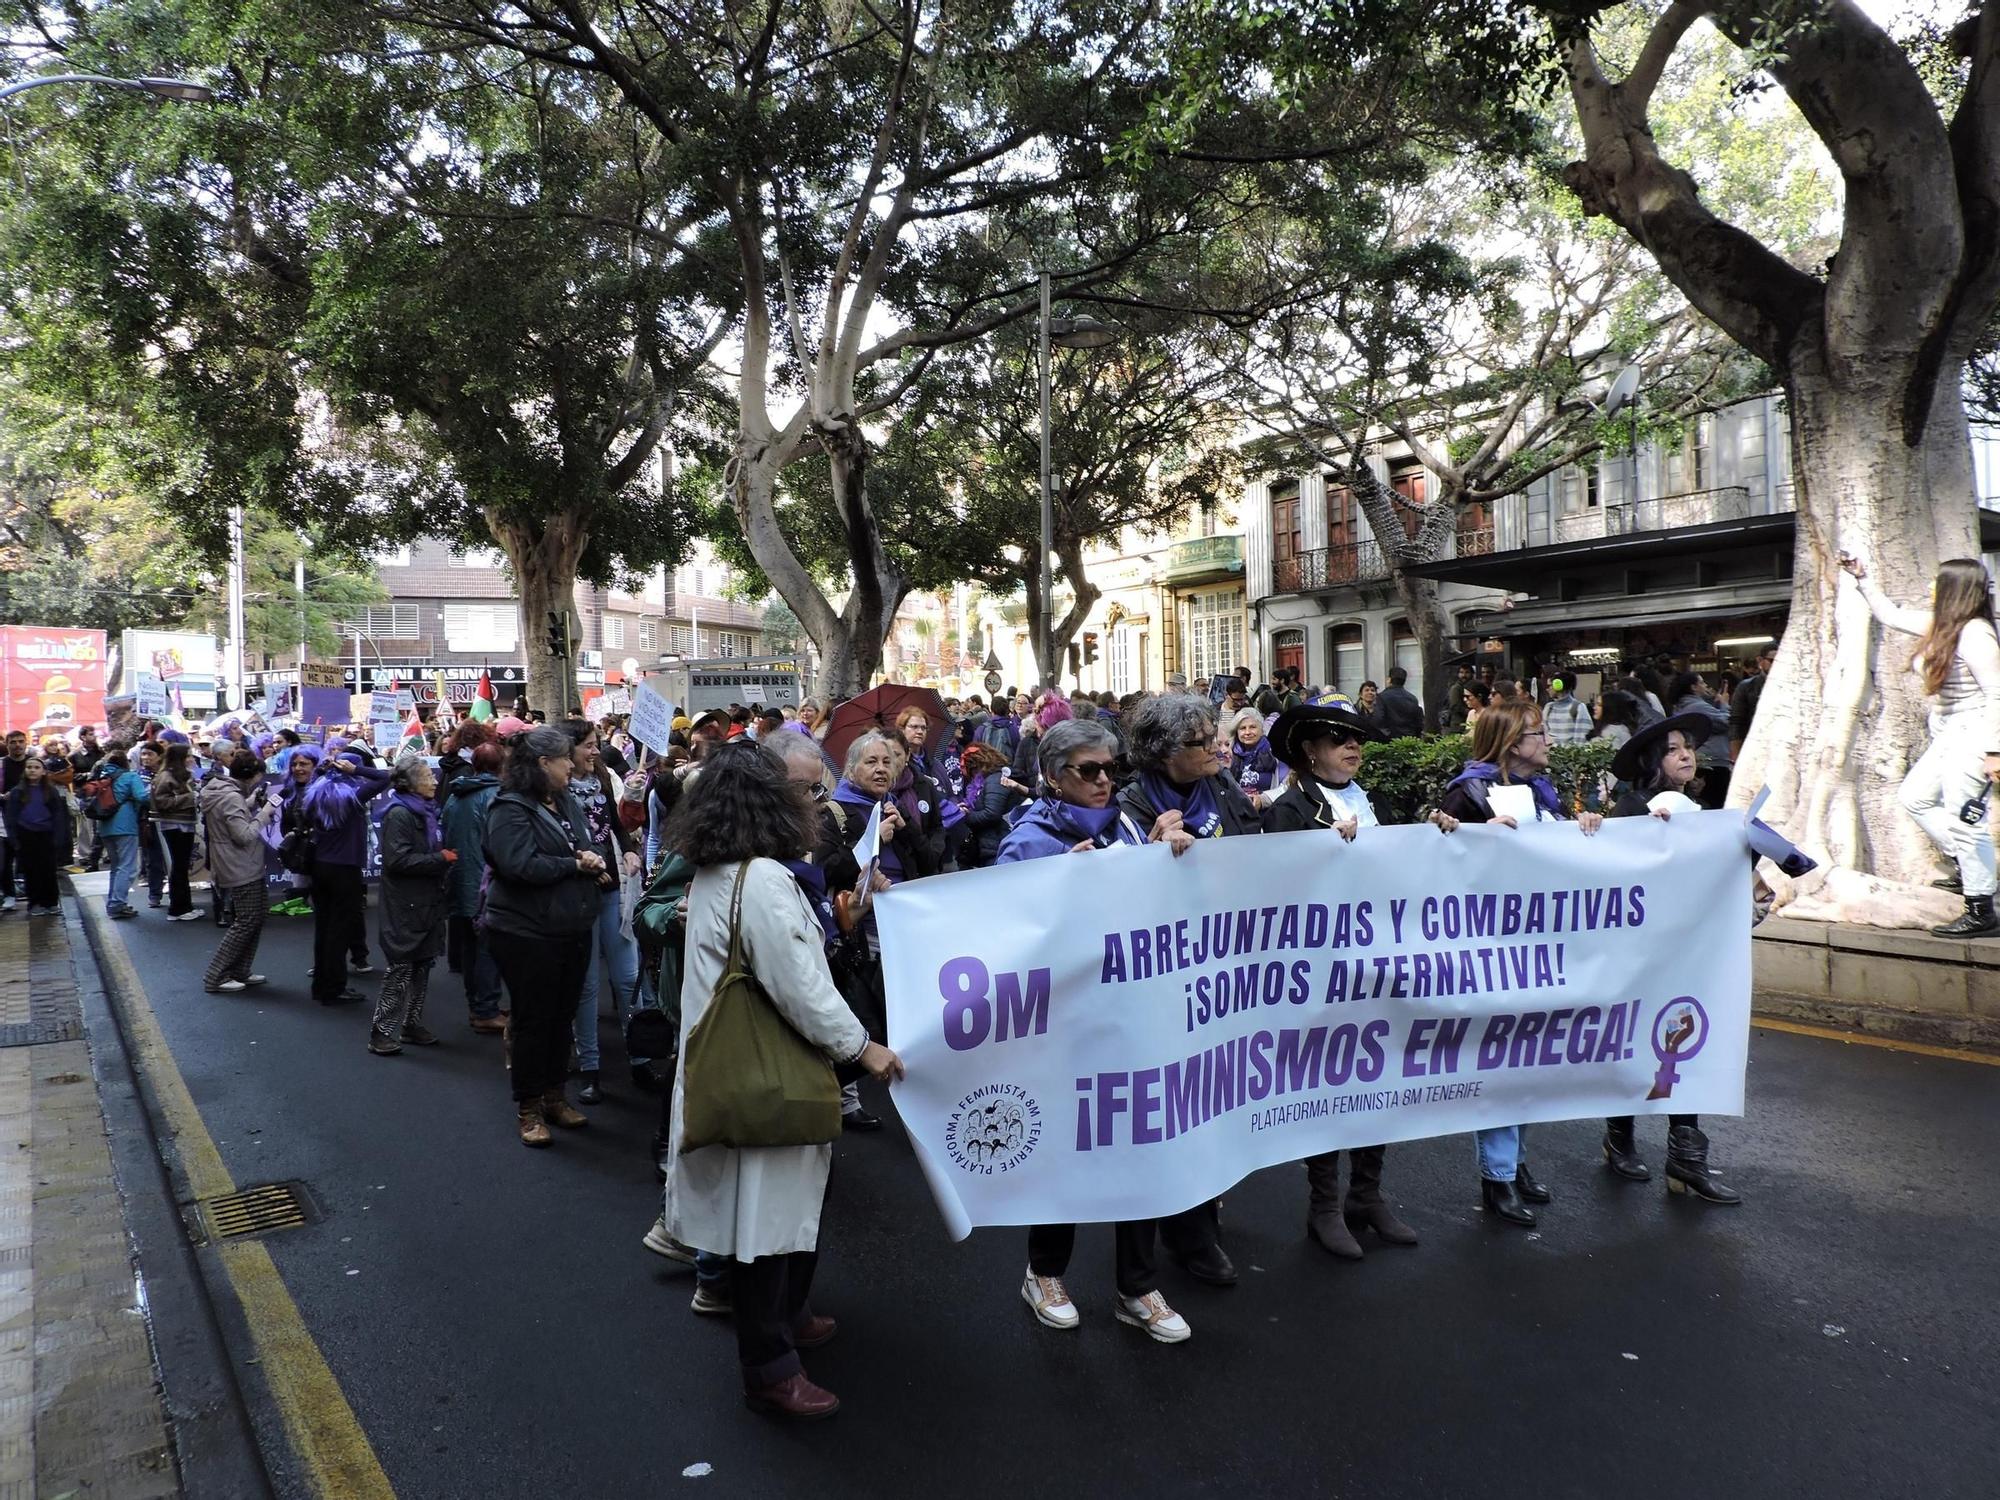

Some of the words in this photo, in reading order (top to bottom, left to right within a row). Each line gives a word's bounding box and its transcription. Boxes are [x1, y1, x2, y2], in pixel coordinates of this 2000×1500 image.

[774, 689, 791, 699] WC
[1101, 900, 1373, 984] ARREJUNTADAS
[1390, 898, 1408, 944] Y
[1421, 884, 1645, 941] COMBATIVAS
[938, 956, 1051, 1051] 8M
[1185, 960, 1310, 1032] ¡SOMOS
[1325, 943, 1566, 1004] ALTERNATIVA!
[958, 1083, 1027, 1111] FEMINISTA
[1075, 1018, 1390, 1152] ¡FEMINISMOS
[1402, 1016, 1471, 1079] EN
[1476, 999, 1642, 1071] BREGA!
[1025, 1098, 1041, 1118] 8M
[1250, 1099, 1328, 1133] PLATAFORMA
[1332, 1090, 1399, 1116] FEMINISTA
[1402, 1087, 1423, 1106] 8M
[1426, 1081, 1484, 1104] TENERIFE
[945, 1112, 993, 1175] PLATAFORMA
[1000, 1120, 1042, 1173] TENERIFE
